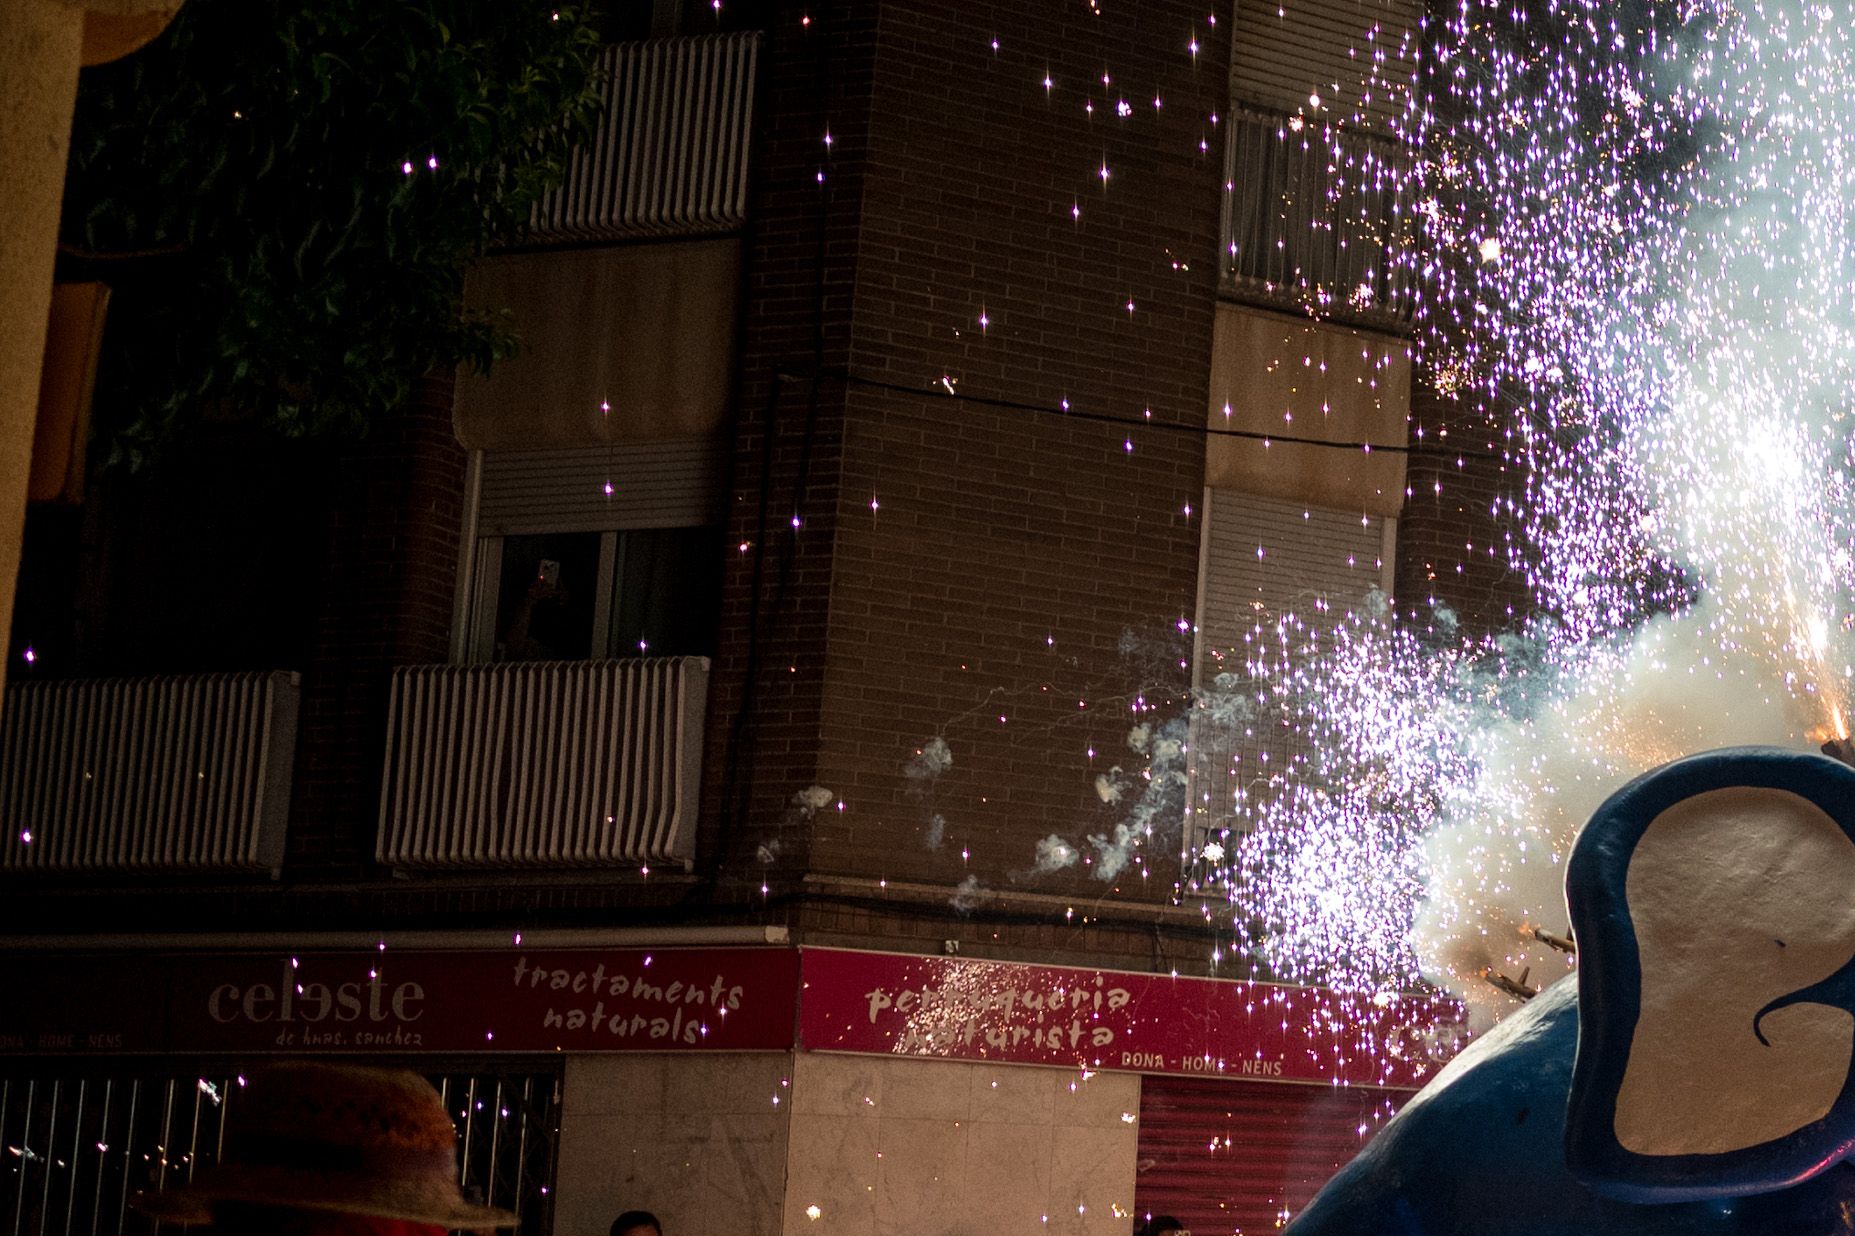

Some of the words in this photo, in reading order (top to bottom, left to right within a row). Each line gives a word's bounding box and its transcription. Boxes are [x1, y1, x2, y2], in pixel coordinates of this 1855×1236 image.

[208, 957, 425, 1023] celeste
[513, 955, 744, 1010] tractaments
[864, 974, 1132, 1025] perruqueria
[0, 1033, 24, 1048] ONA
[275, 1028, 294, 1047] de
[543, 1001, 700, 1044] naturals
[903, 1011, 1114, 1052] naturista
[1121, 1051, 1165, 1069] DONA
[1242, 1059, 1282, 1075] NENS
